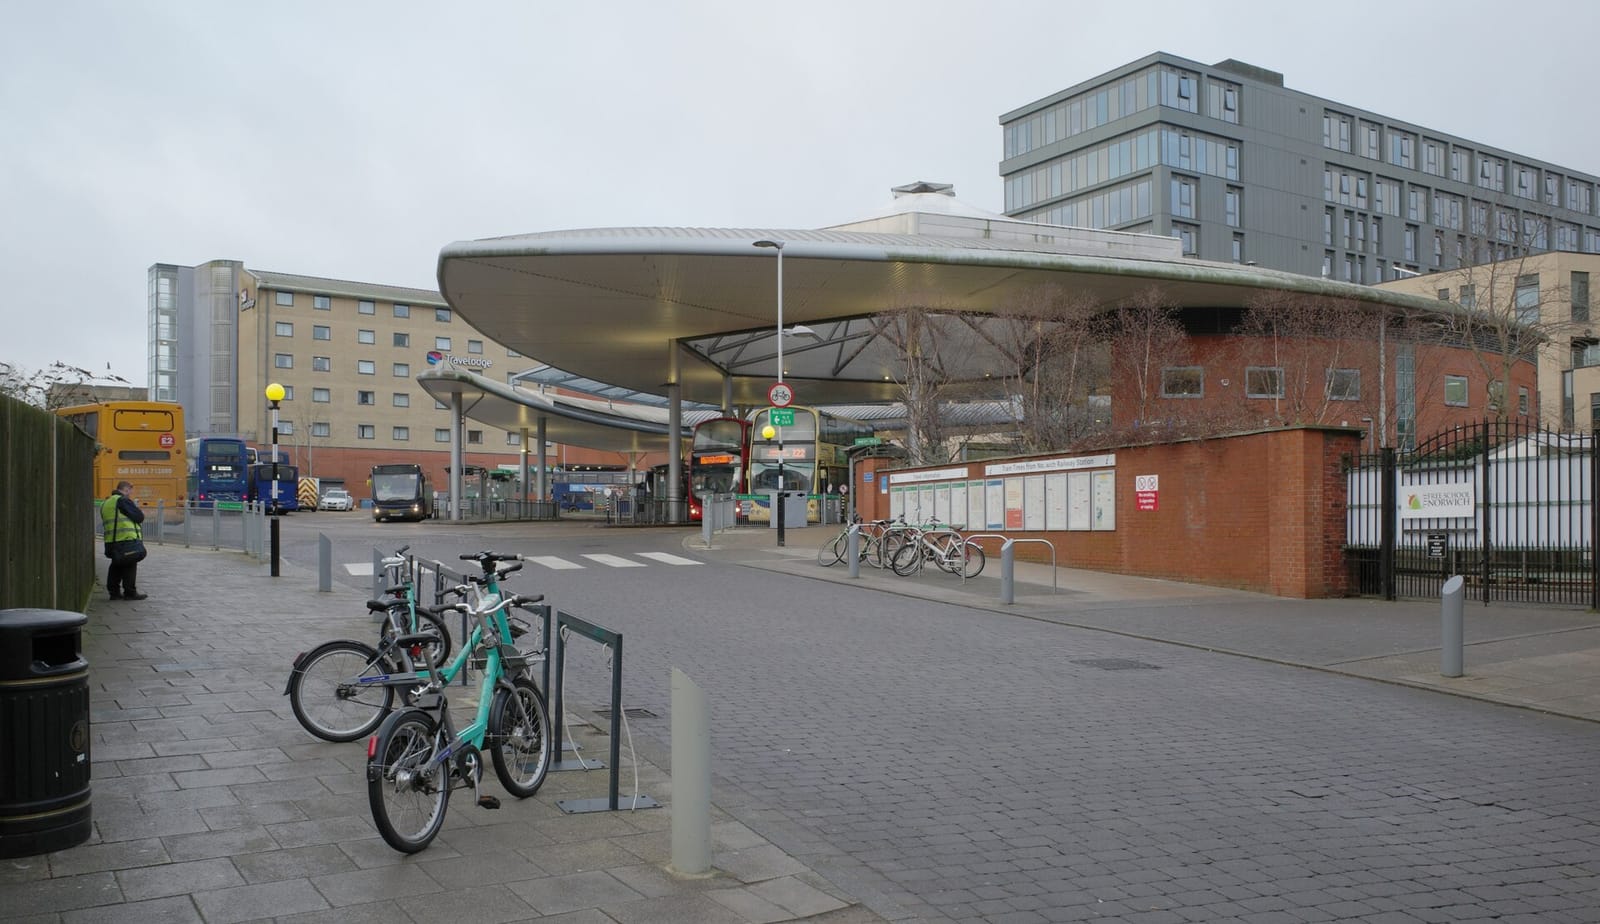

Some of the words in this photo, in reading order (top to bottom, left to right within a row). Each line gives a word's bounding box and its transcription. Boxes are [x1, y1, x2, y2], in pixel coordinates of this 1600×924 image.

[447, 354, 493, 368] Travelodge
[1013, 464, 1025, 472] Times
[1025, 463, 1036, 471] from
[1057, 460, 1075, 469] Railway
[1076, 458, 1094, 466] Station
[1428, 498, 1470, 507] NORWICH
